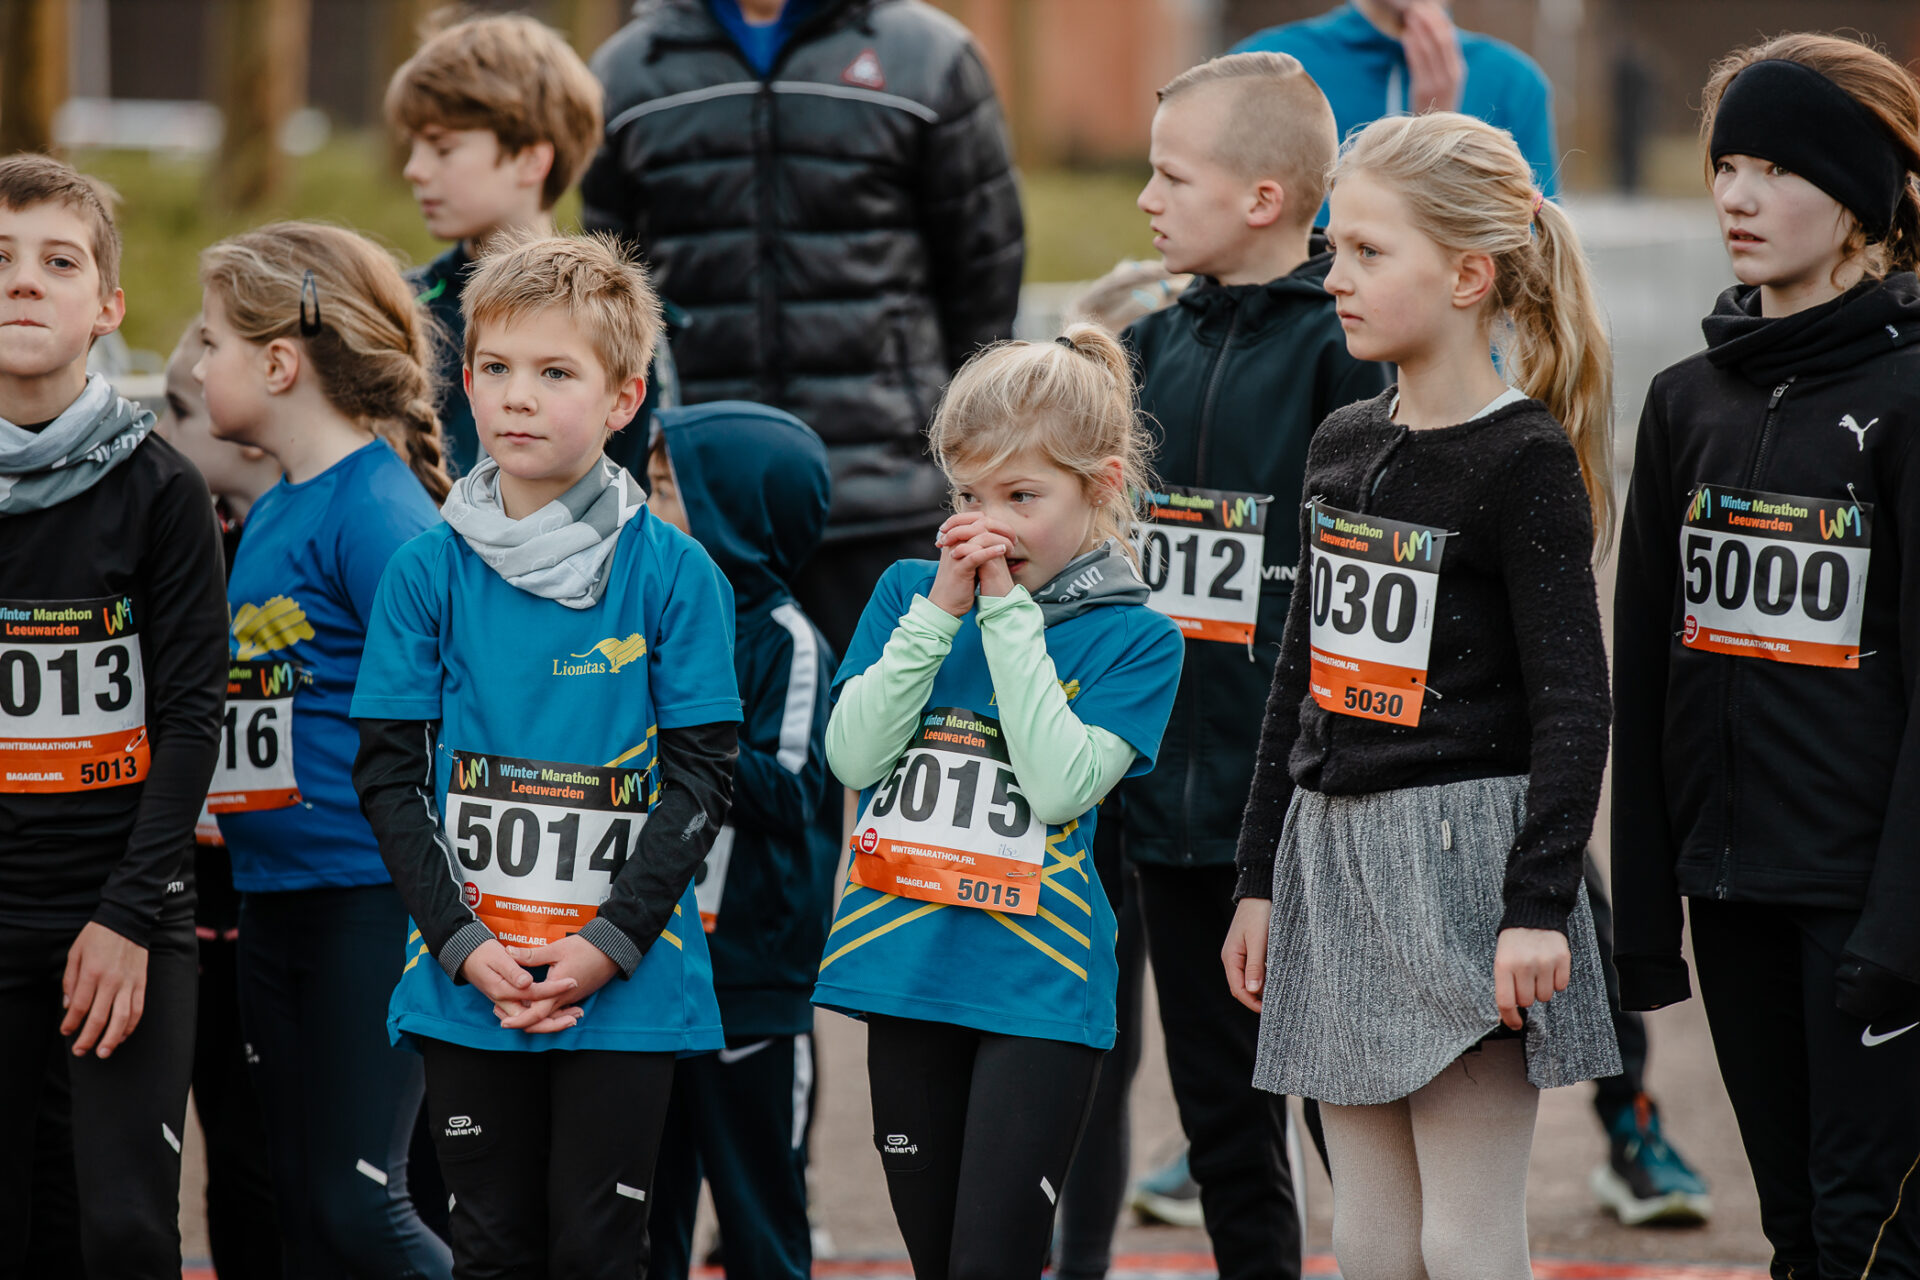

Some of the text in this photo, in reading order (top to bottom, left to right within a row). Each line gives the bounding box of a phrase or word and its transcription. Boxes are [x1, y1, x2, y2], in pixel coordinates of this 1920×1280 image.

[1720, 494, 1808, 518] Winter Marathon
[1317, 511, 1384, 539] Winter Marathon
[1728, 511, 1793, 532] Leeuwarden
[1320, 529, 1369, 552] Leeuwarden
[1129, 528, 1246, 602] 012
[1685, 534, 1850, 622] 5000
[1310, 552, 1418, 643] 030
[33, 608, 93, 621] Marathon
[6, 622, 80, 636] Leeuwarden
[1709, 633, 1791, 653] WINTERMARATHON.FRL
[552, 659, 606, 676] Lionitas
[1344, 686, 1404, 718] 5030
[924, 714, 998, 738] Winter Marathon
[0, 740, 93, 751] WINTERMARATHON.FRL
[924, 728, 986, 748] Leeuwarden
[6, 756, 137, 785] BAGAGELABEL 5013
[500, 764, 599, 786] Winter Marathon
[511, 780, 585, 800] Leeuwarden
[872, 753, 1031, 838] 5015
[457, 802, 632, 885] 5014
[891, 844, 976, 866] WINTERMARATHON.FRL
[896, 876, 1021, 908] BAGAGELABEL 5015
[495, 900, 579, 917] WINTERMARATHON.FRL
[499, 932, 547, 946] BAGAGELABEL
[445, 1125, 482, 1137] Kalenji
[884, 1144, 918, 1155] Kalenji
